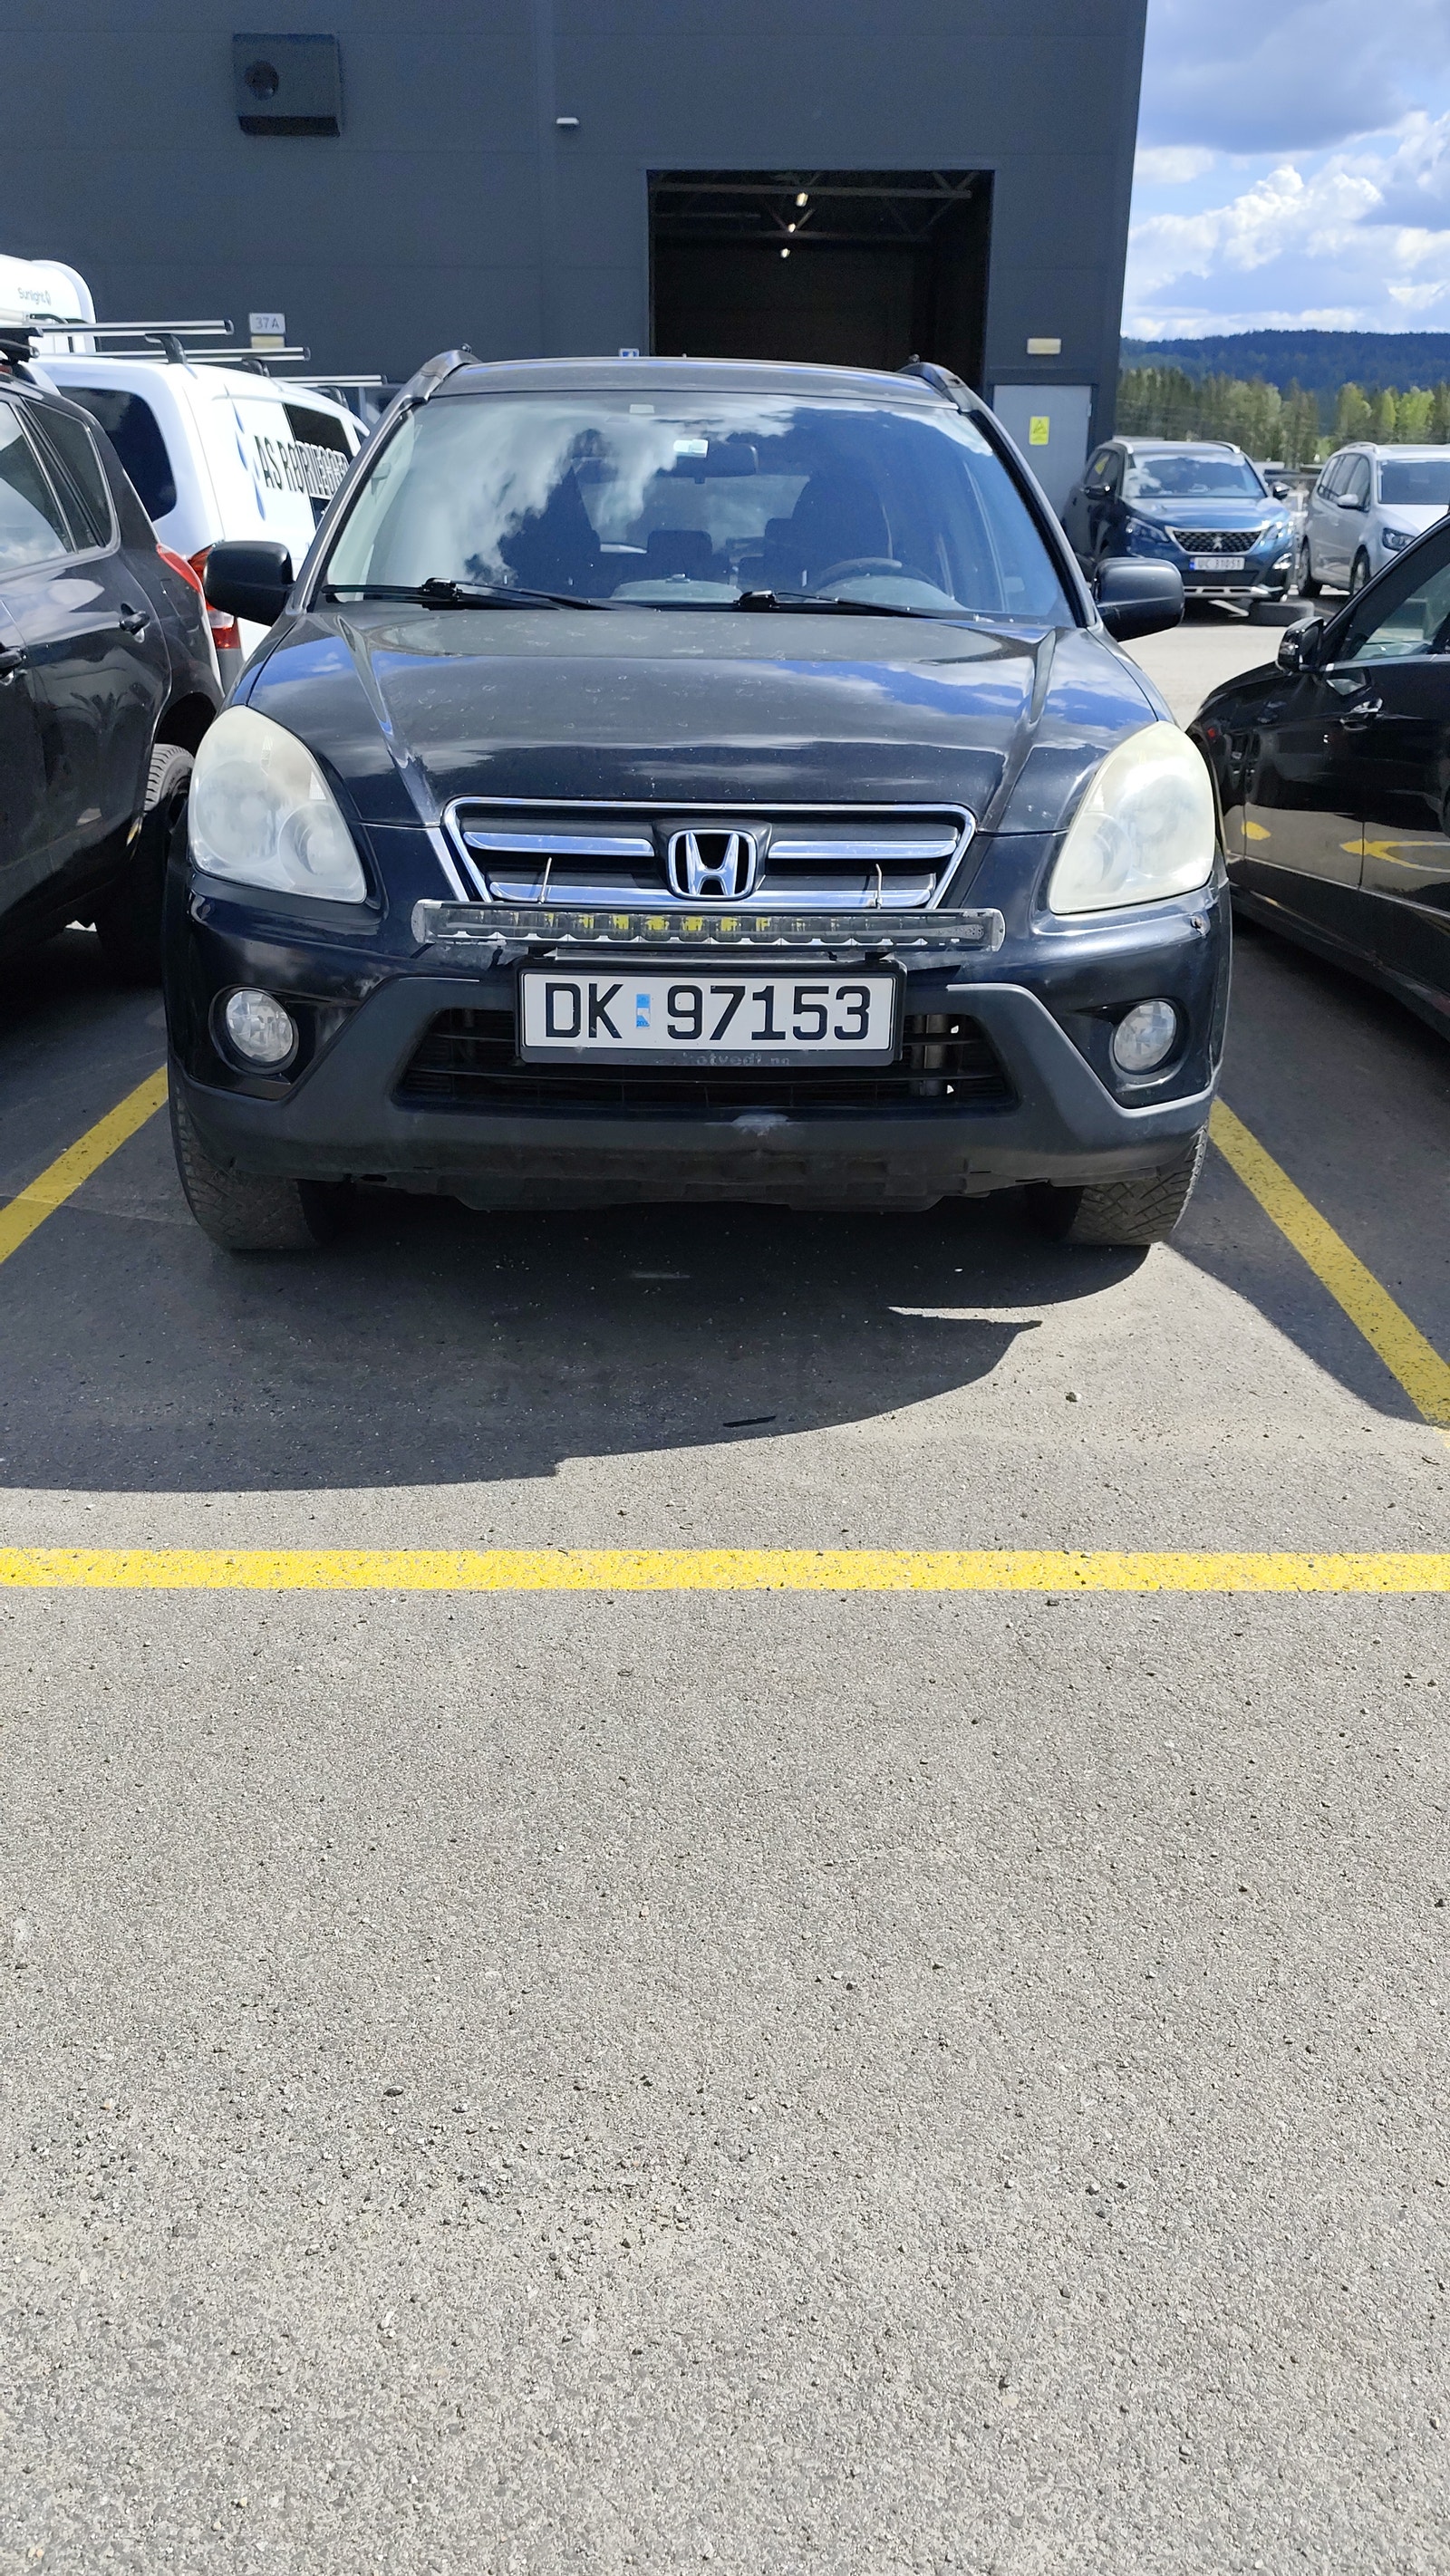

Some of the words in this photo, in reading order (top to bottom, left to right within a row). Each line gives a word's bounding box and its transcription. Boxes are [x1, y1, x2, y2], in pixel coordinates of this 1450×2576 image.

[254, 435, 282, 490] AS
[545, 981, 624, 1039] DK
[667, 984, 871, 1041] 97153
